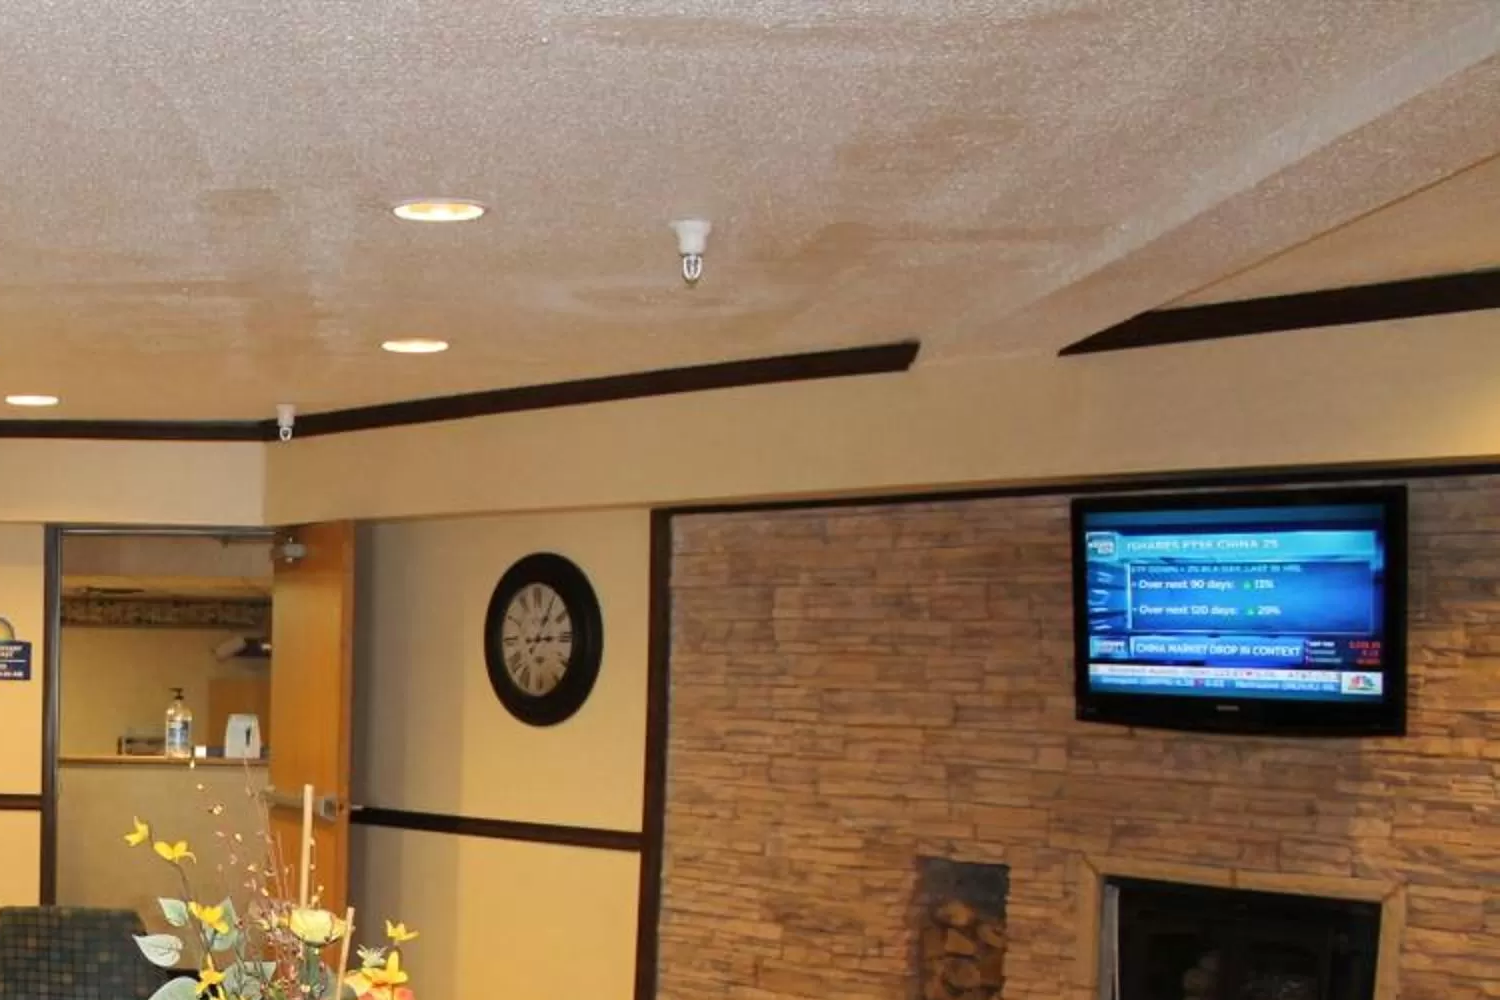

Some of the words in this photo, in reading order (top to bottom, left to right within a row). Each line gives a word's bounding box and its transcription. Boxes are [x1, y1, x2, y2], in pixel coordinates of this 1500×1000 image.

[1139, 579, 1163, 589] Over
[1165, 579, 1188, 589] next
[1139, 605, 1163, 615] Over
[1165, 605, 1189, 615] next
[1136, 643, 1166, 654] CHINA
[1168, 643, 1207, 654] MARKET
[1209, 644, 1239, 655] DROP
[1252, 645, 1301, 657] CONTEXT
